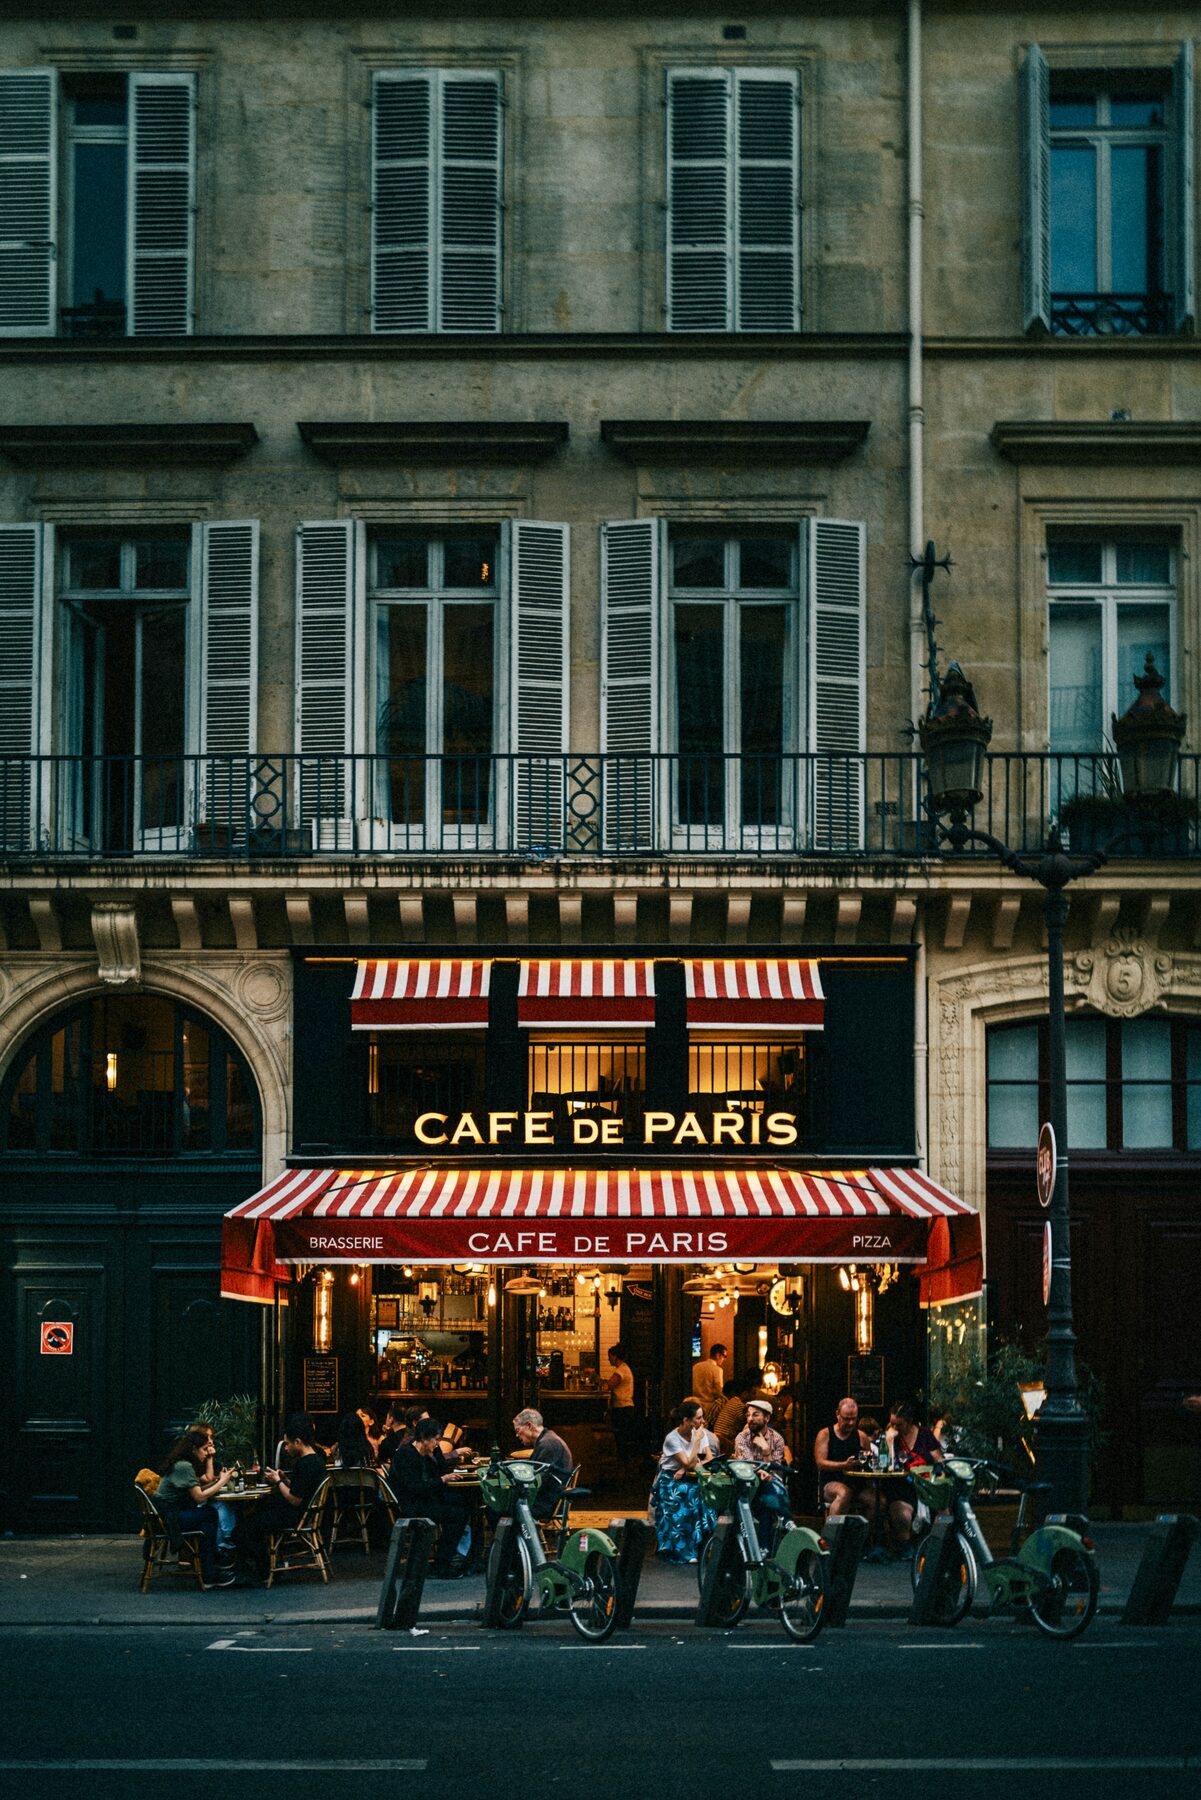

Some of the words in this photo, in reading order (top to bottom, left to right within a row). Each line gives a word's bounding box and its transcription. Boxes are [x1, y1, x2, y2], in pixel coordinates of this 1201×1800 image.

[1117, 969, 1131, 995] 5
[413, 1111, 555, 1145] CAFE
[573, 1118, 625, 1145] DE
[643, 1111, 799, 1145] PARIS
[309, 1236, 384, 1250] BRASSERIE
[467, 1231, 558, 1253] CAFE
[573, 1236, 611, 1253] DE
[626, 1231, 729, 1253] PARIS
[852, 1235, 892, 1248] PIZZA
